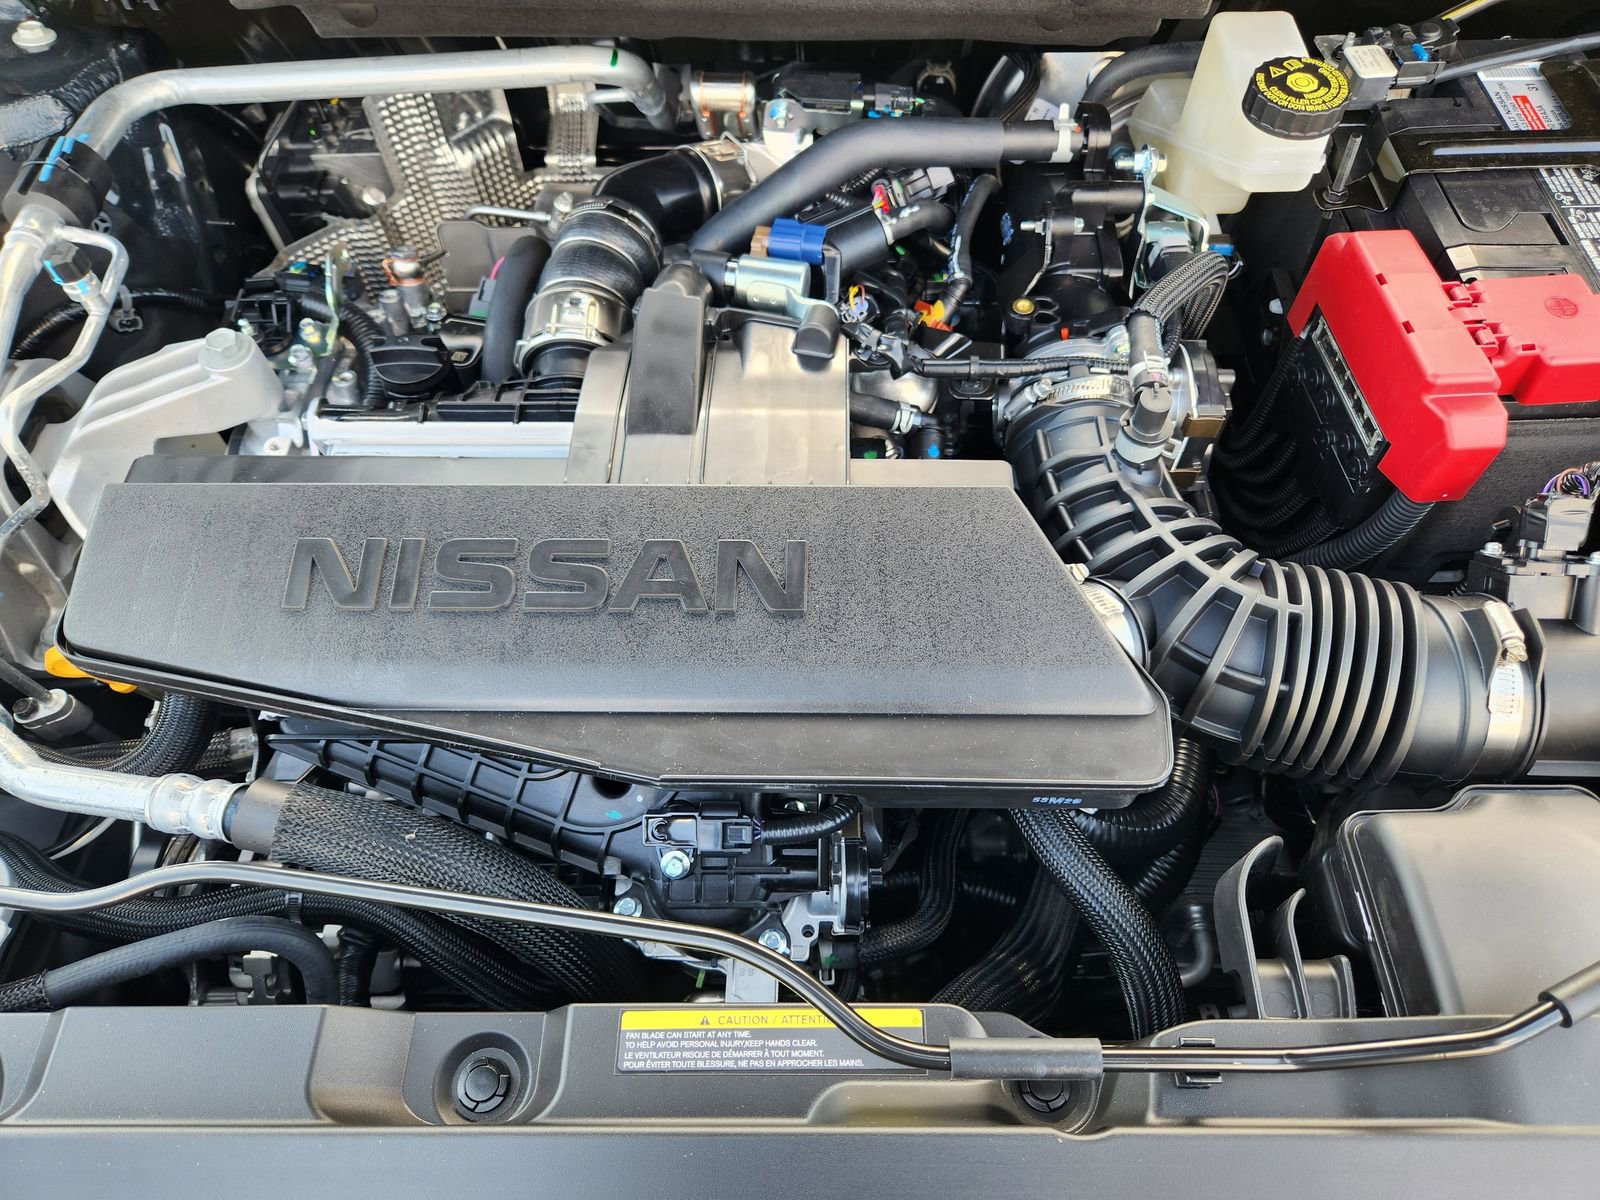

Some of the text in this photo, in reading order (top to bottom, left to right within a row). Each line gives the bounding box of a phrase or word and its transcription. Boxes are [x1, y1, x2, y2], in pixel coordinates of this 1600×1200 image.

[1525, 83, 1538, 92] 31
[1269, 86, 1288, 100] CLEAN
[1287, 96, 1310, 106] FILLER
[1310, 98, 1323, 106] CAP
[1263, 91, 1279, 102] DOT3
[1277, 99, 1288, 107] OR
[1287, 102, 1306, 111] DOT4
[1305, 103, 1328, 112] BRAKE
[281, 537, 809, 614] NISSAN
[718, 1015, 768, 1025] CAUTION
[641, 1031, 665, 1039] BLADE
[666, 1031, 682, 1039] CAN
[683, 1031, 706, 1039] START
[734, 1030, 752, 1038] TIME.
[625, 1041, 635, 1049] TO
[680, 1040, 719, 1048] PERSONAL
[792, 1039, 818, 1047] CLEAR.
[634, 1051, 681, 1059] VENTILATEUR
[682, 1051, 710, 1059] RISQUE
[722, 1049, 763, 1058] DÉMARRER
[624, 1061, 645, 1069] POUR
[646, 1059, 671, 1068] ÉVITER
[696, 1060, 737, 1068] BLESSURE,
[838, 1059, 865, 1067] MAINS.
